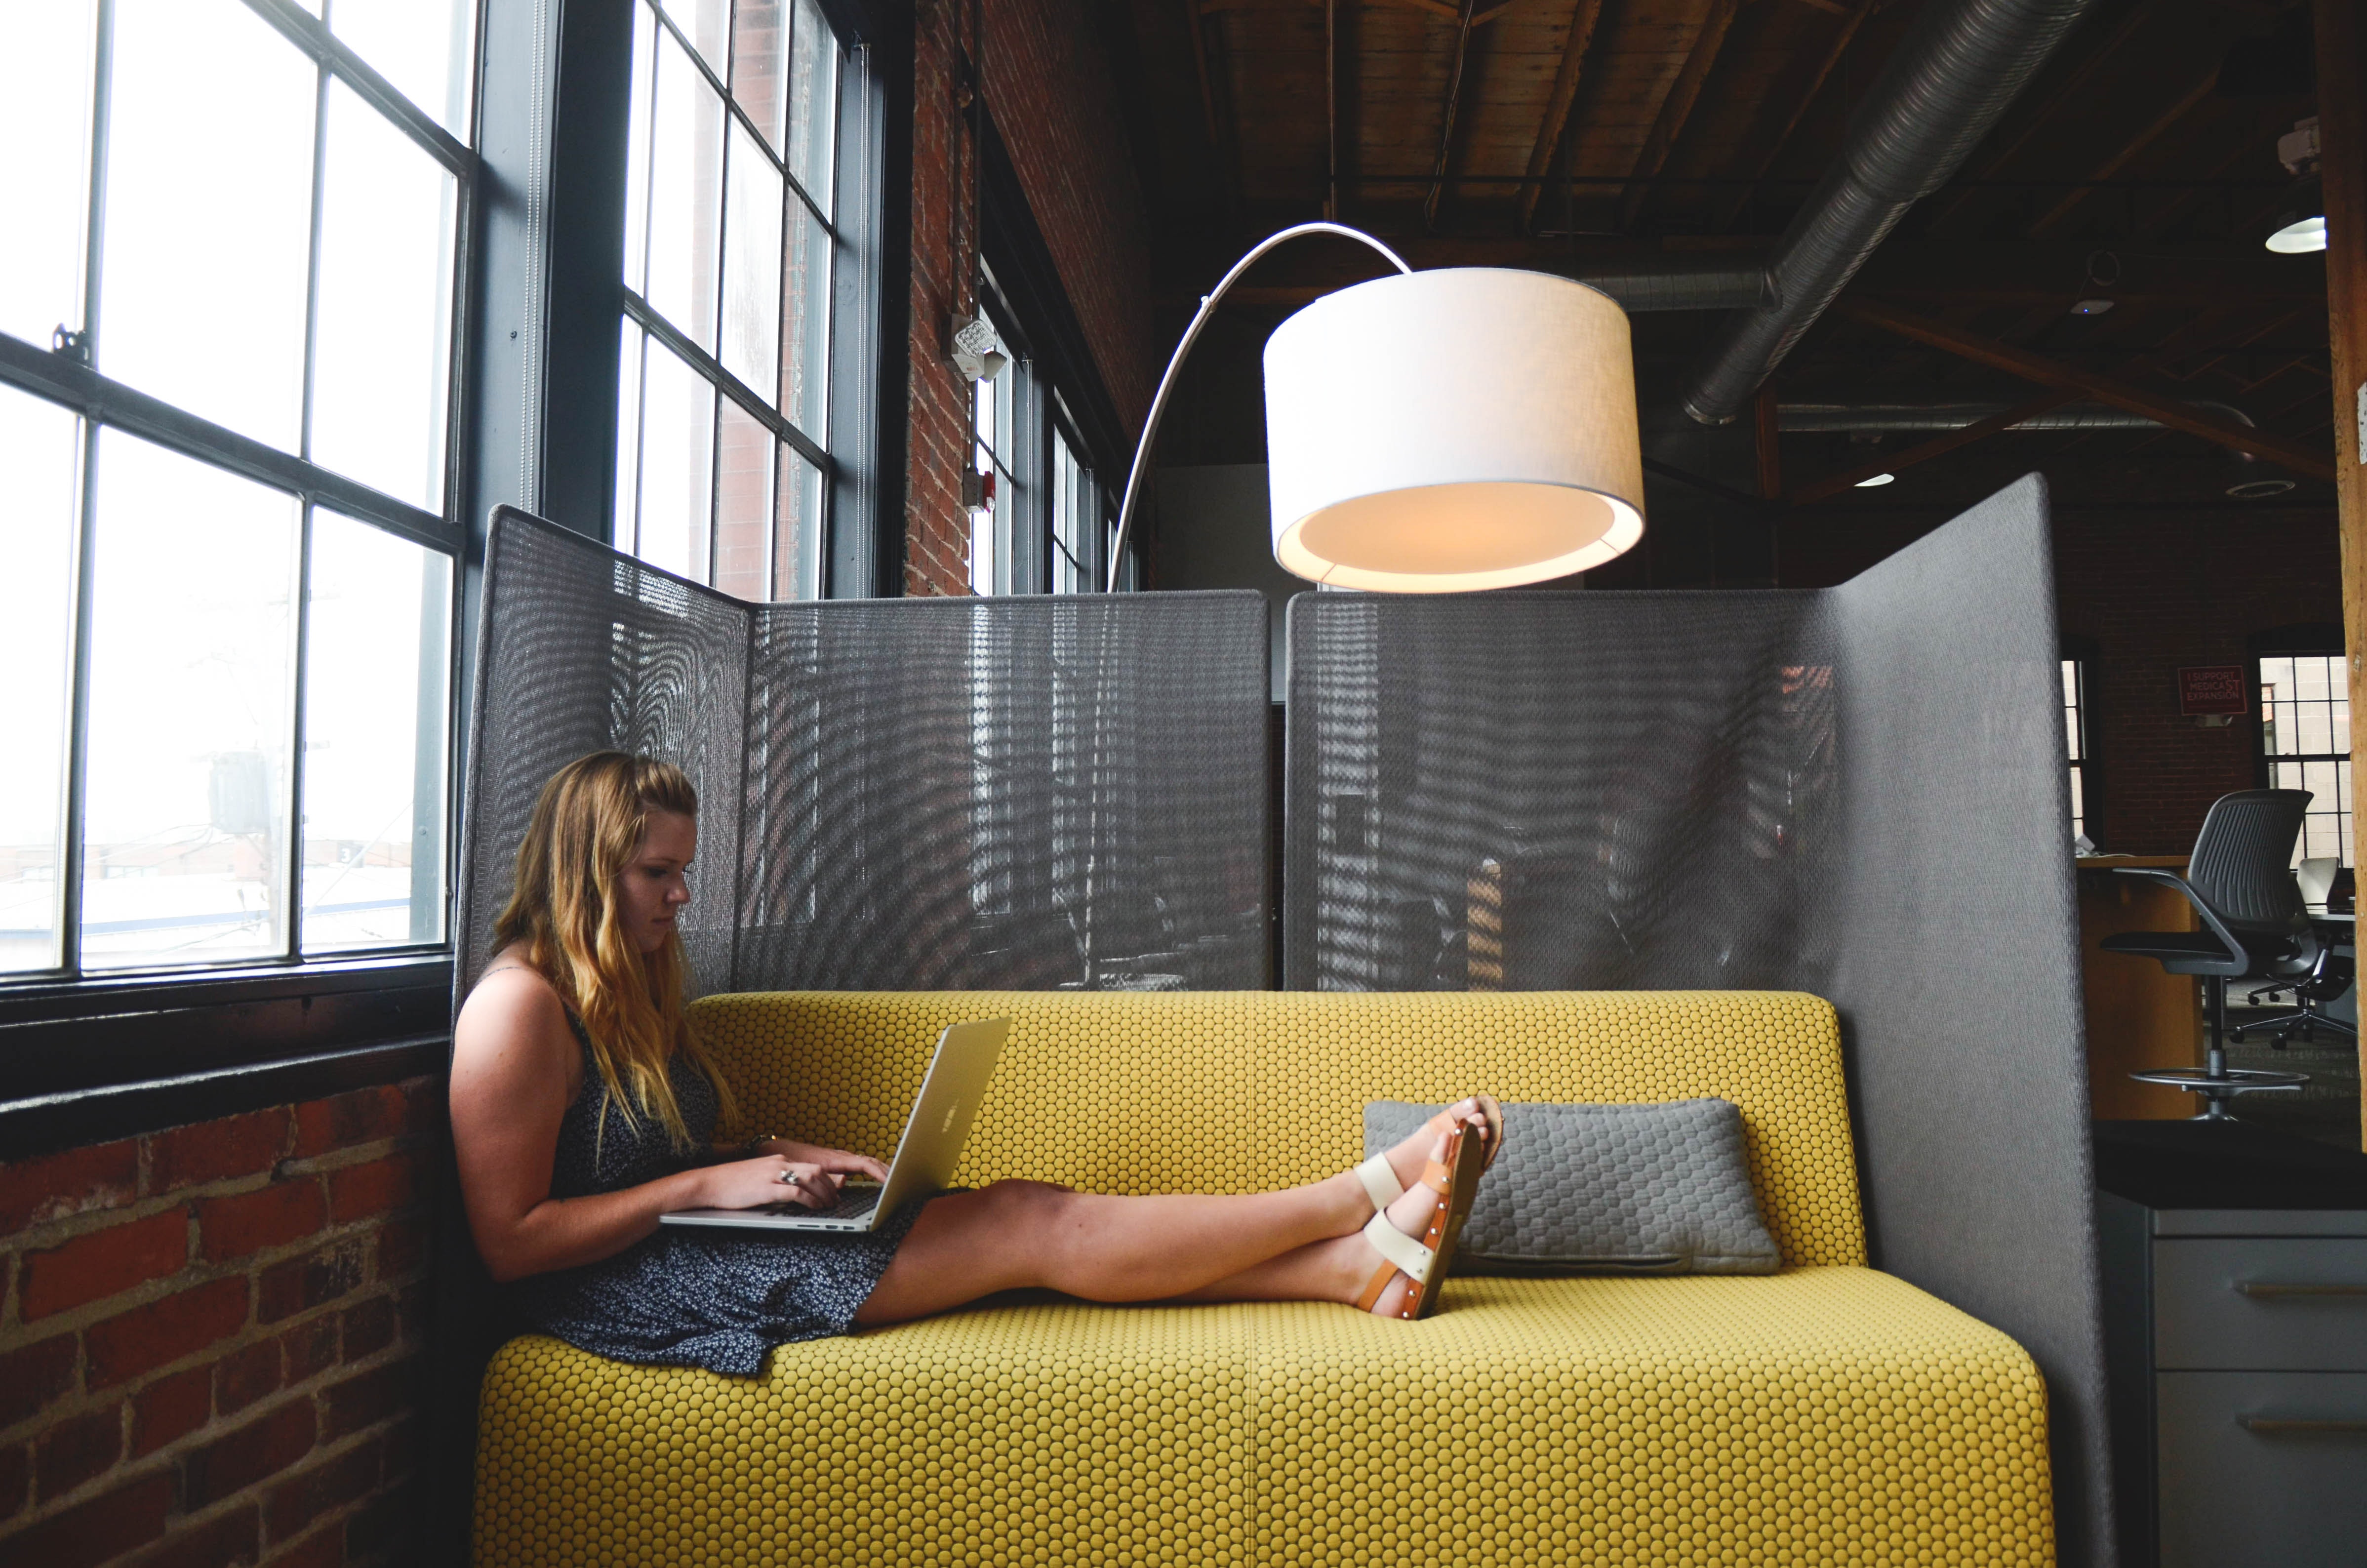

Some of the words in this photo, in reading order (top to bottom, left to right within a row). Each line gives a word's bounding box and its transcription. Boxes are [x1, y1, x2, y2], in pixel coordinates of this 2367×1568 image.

[2192, 671, 2234, 681] SUPPORT
[2187, 691, 2239, 701] EXPANSION
[341, 848, 350, 862] 3
